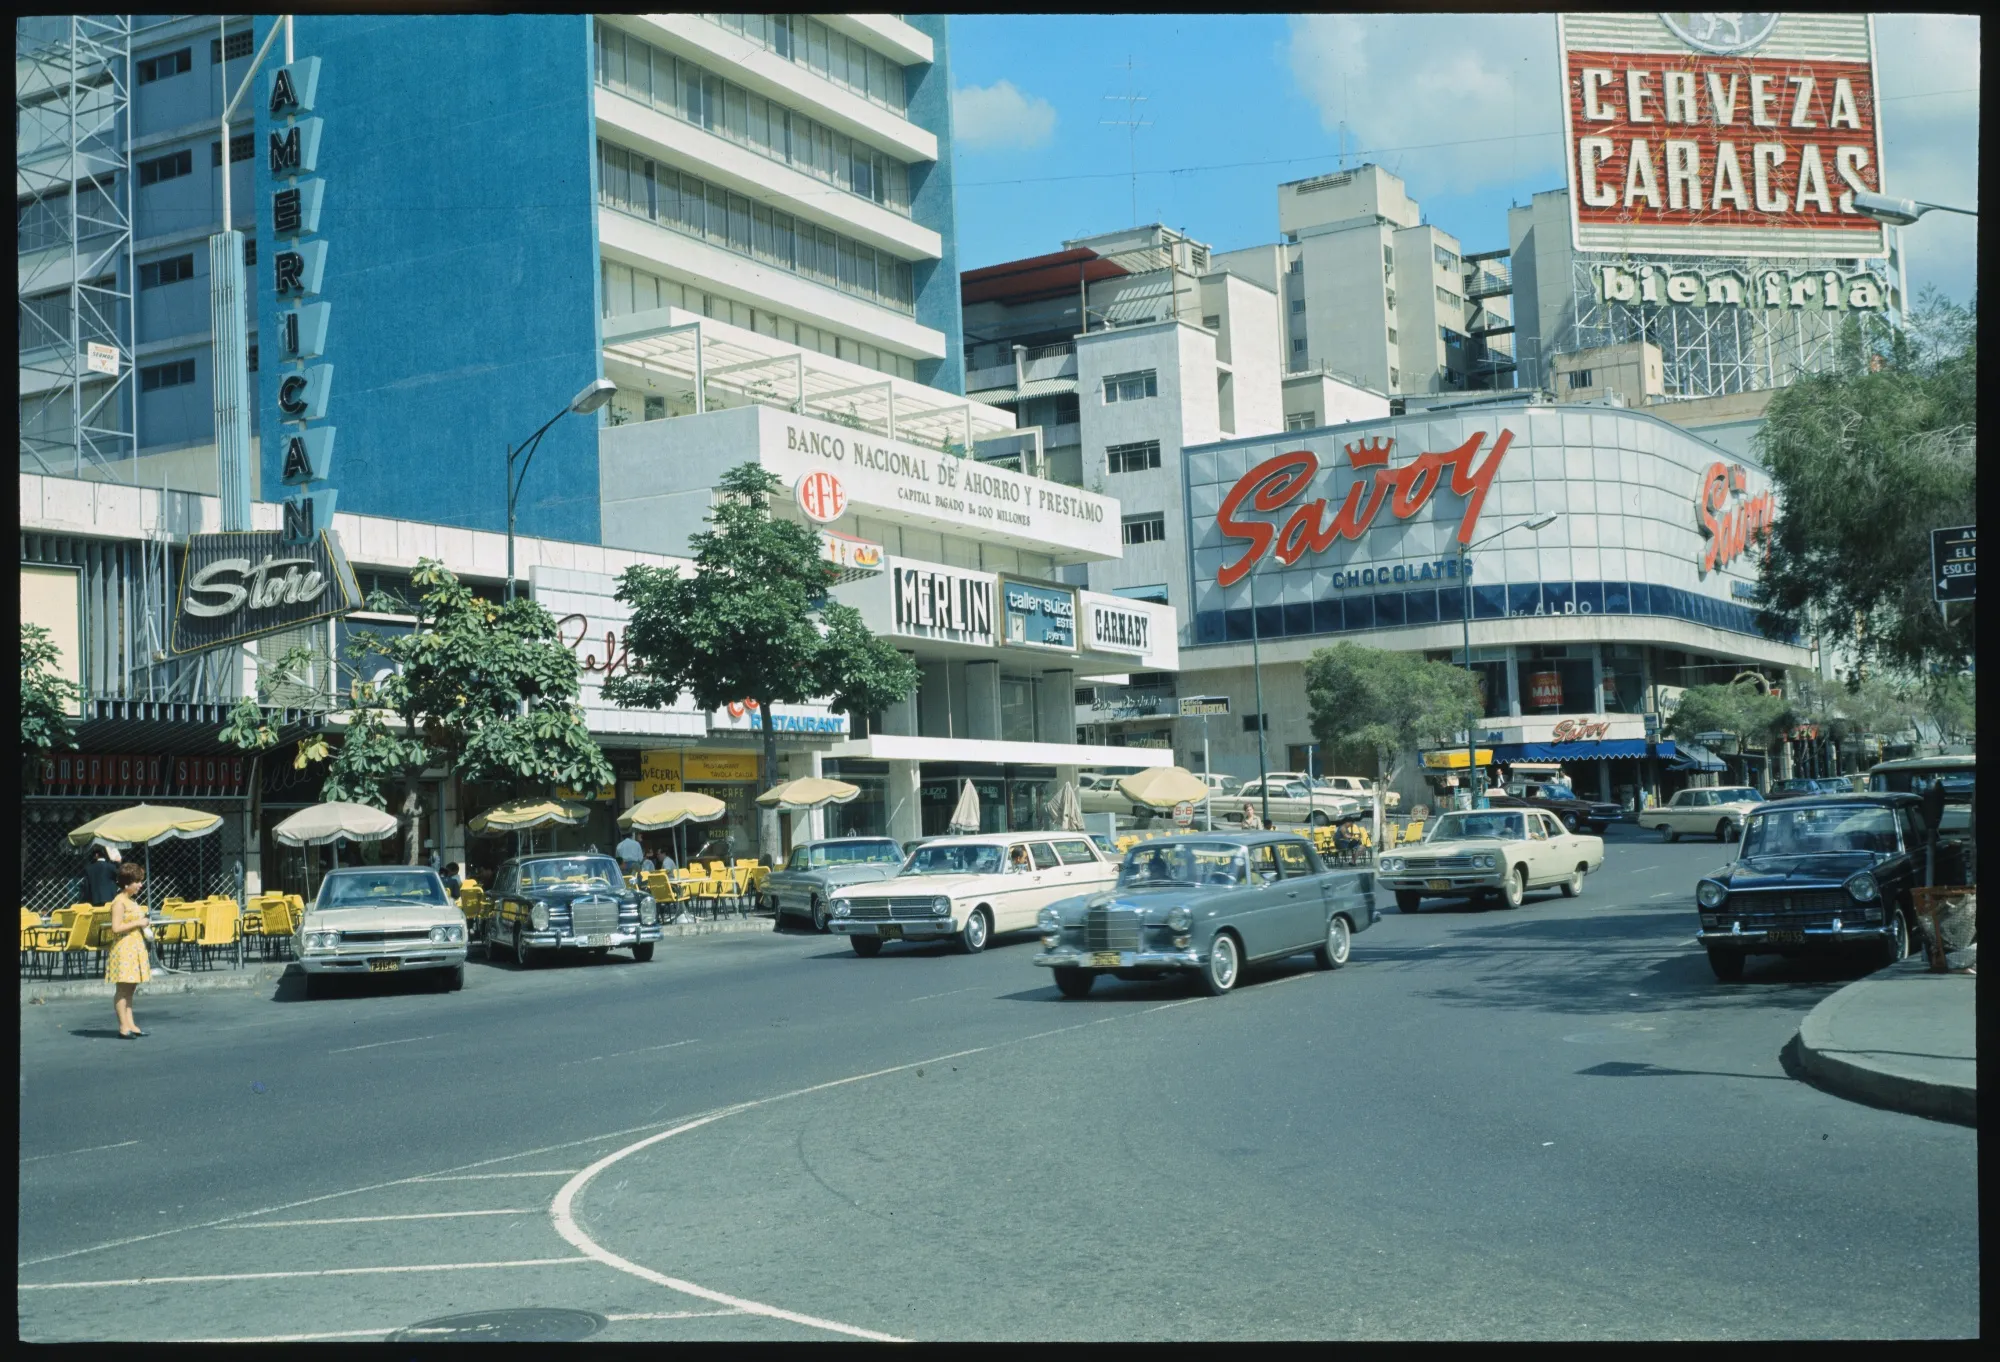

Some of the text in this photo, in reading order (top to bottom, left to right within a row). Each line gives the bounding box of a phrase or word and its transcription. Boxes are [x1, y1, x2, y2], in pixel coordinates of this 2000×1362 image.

[1582, 67, 1862, 130] CERVEZA
[1579, 134, 1874, 214] CARACAS
[267, 67, 314, 543] AMERICAN
[1602, 266, 1881, 307] bien fria
[786, 425, 1104, 523] BANCO NACIONAL DE AHORRO Y PRESTAMO
[803, 472, 843, 518] EFE
[898, 487, 931, 505] CAPITAL
[935, 495, 964, 512] PAGADO
[978, 506, 993, 519] 200
[996, 509, 1031, 527] MILLONES
[1216, 428, 1516, 587] Savoy
[1956, 547, 1969, 558] EL
[184, 555, 330, 617] Store
[1332, 557, 1474, 590] CHOCOLATES
[895, 567, 995, 636] MERLIN
[1009, 590, 1073, 615] taller suizo
[1534, 601, 1592, 616] ALDO
[1056, 616, 1074, 630] ESTE
[1094, 608, 1148, 648] CARNABY
[751, 713, 844, 732] RSTAURANT
[1553, 720, 1611, 744] Savoy
[45, 759, 160, 782] american
[651, 783, 676, 793] CAFE
